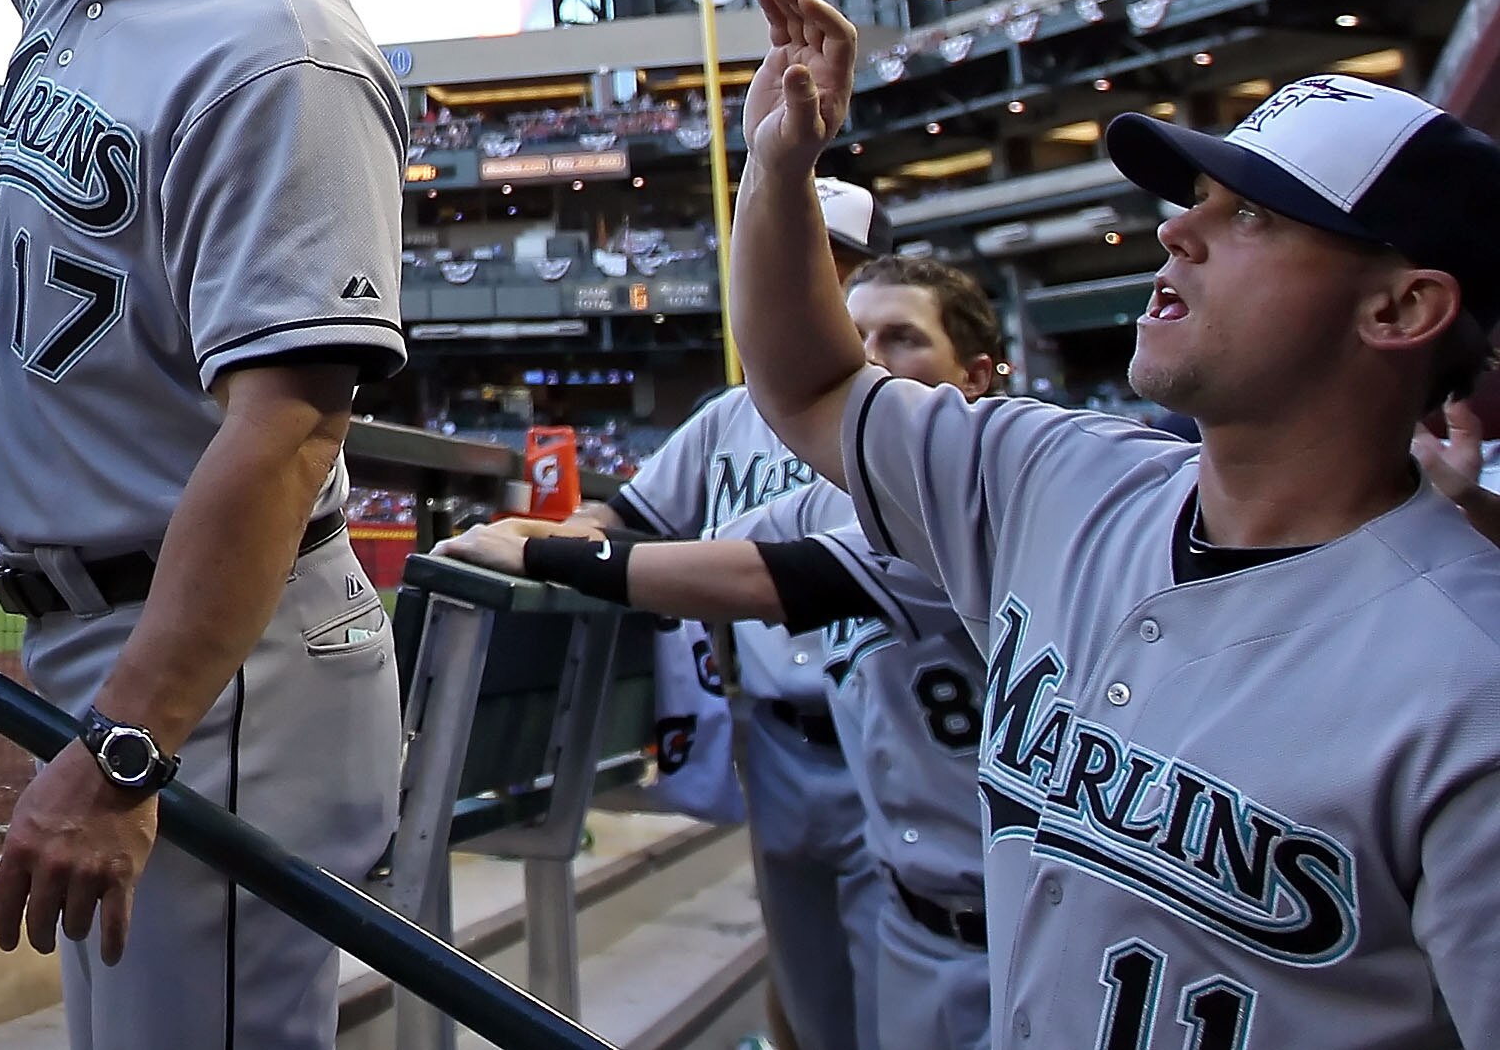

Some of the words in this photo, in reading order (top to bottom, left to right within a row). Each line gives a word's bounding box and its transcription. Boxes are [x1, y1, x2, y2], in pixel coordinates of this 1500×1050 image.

[11, 227, 129, 384] 17
[706, 450, 816, 530] MAR
[909, 660, 988, 757] 8
[979, 591, 1360, 969] MARLINS
